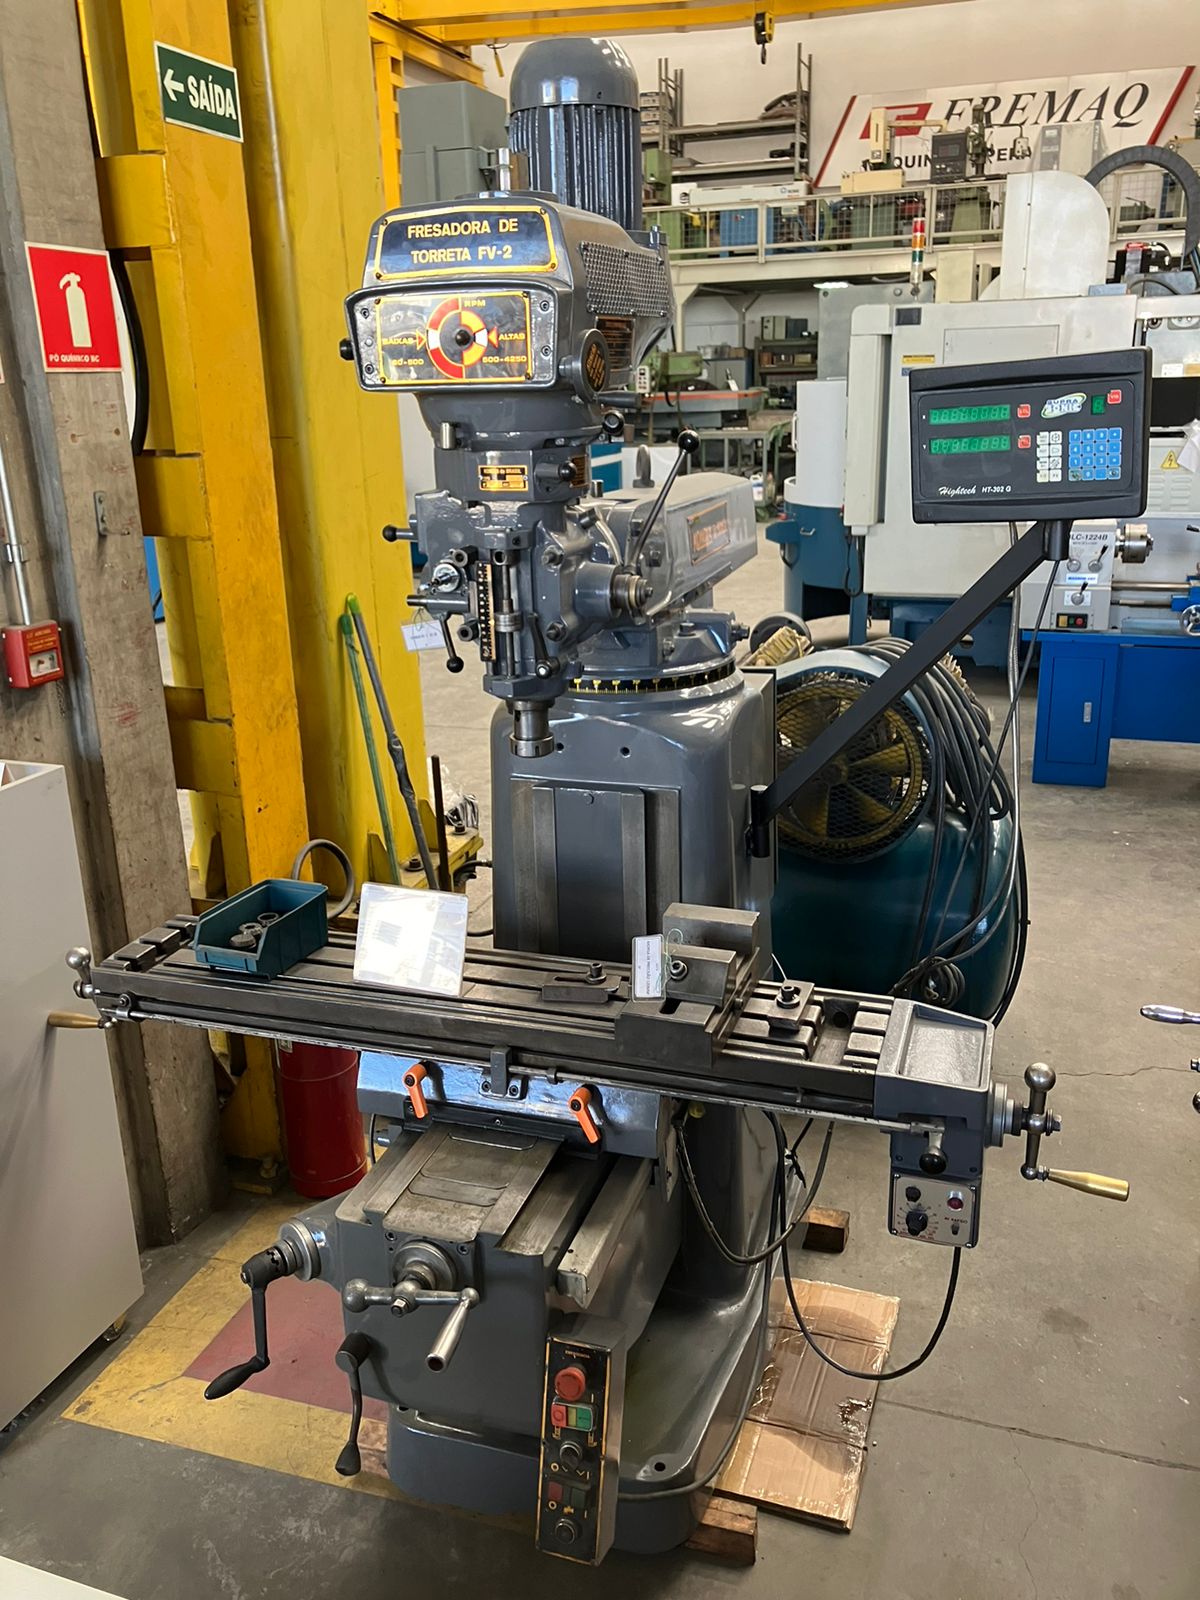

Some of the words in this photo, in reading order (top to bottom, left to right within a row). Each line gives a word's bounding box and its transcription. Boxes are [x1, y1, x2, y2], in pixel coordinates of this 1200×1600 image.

[187, 74, 237, 120] SAÍDA
[943, 83, 1150, 128] FREMAQ
[407, 220, 491, 239] FRESADORA
[498, 218, 519, 232] DE
[411, 247, 472, 264] TORRETA
[477, 245, 513, 260] FV-2
[498, 333, 526, 341] ALTAS
[48, 353, 60, 362] PÓ
[938, 485, 977, 497] Hightech
